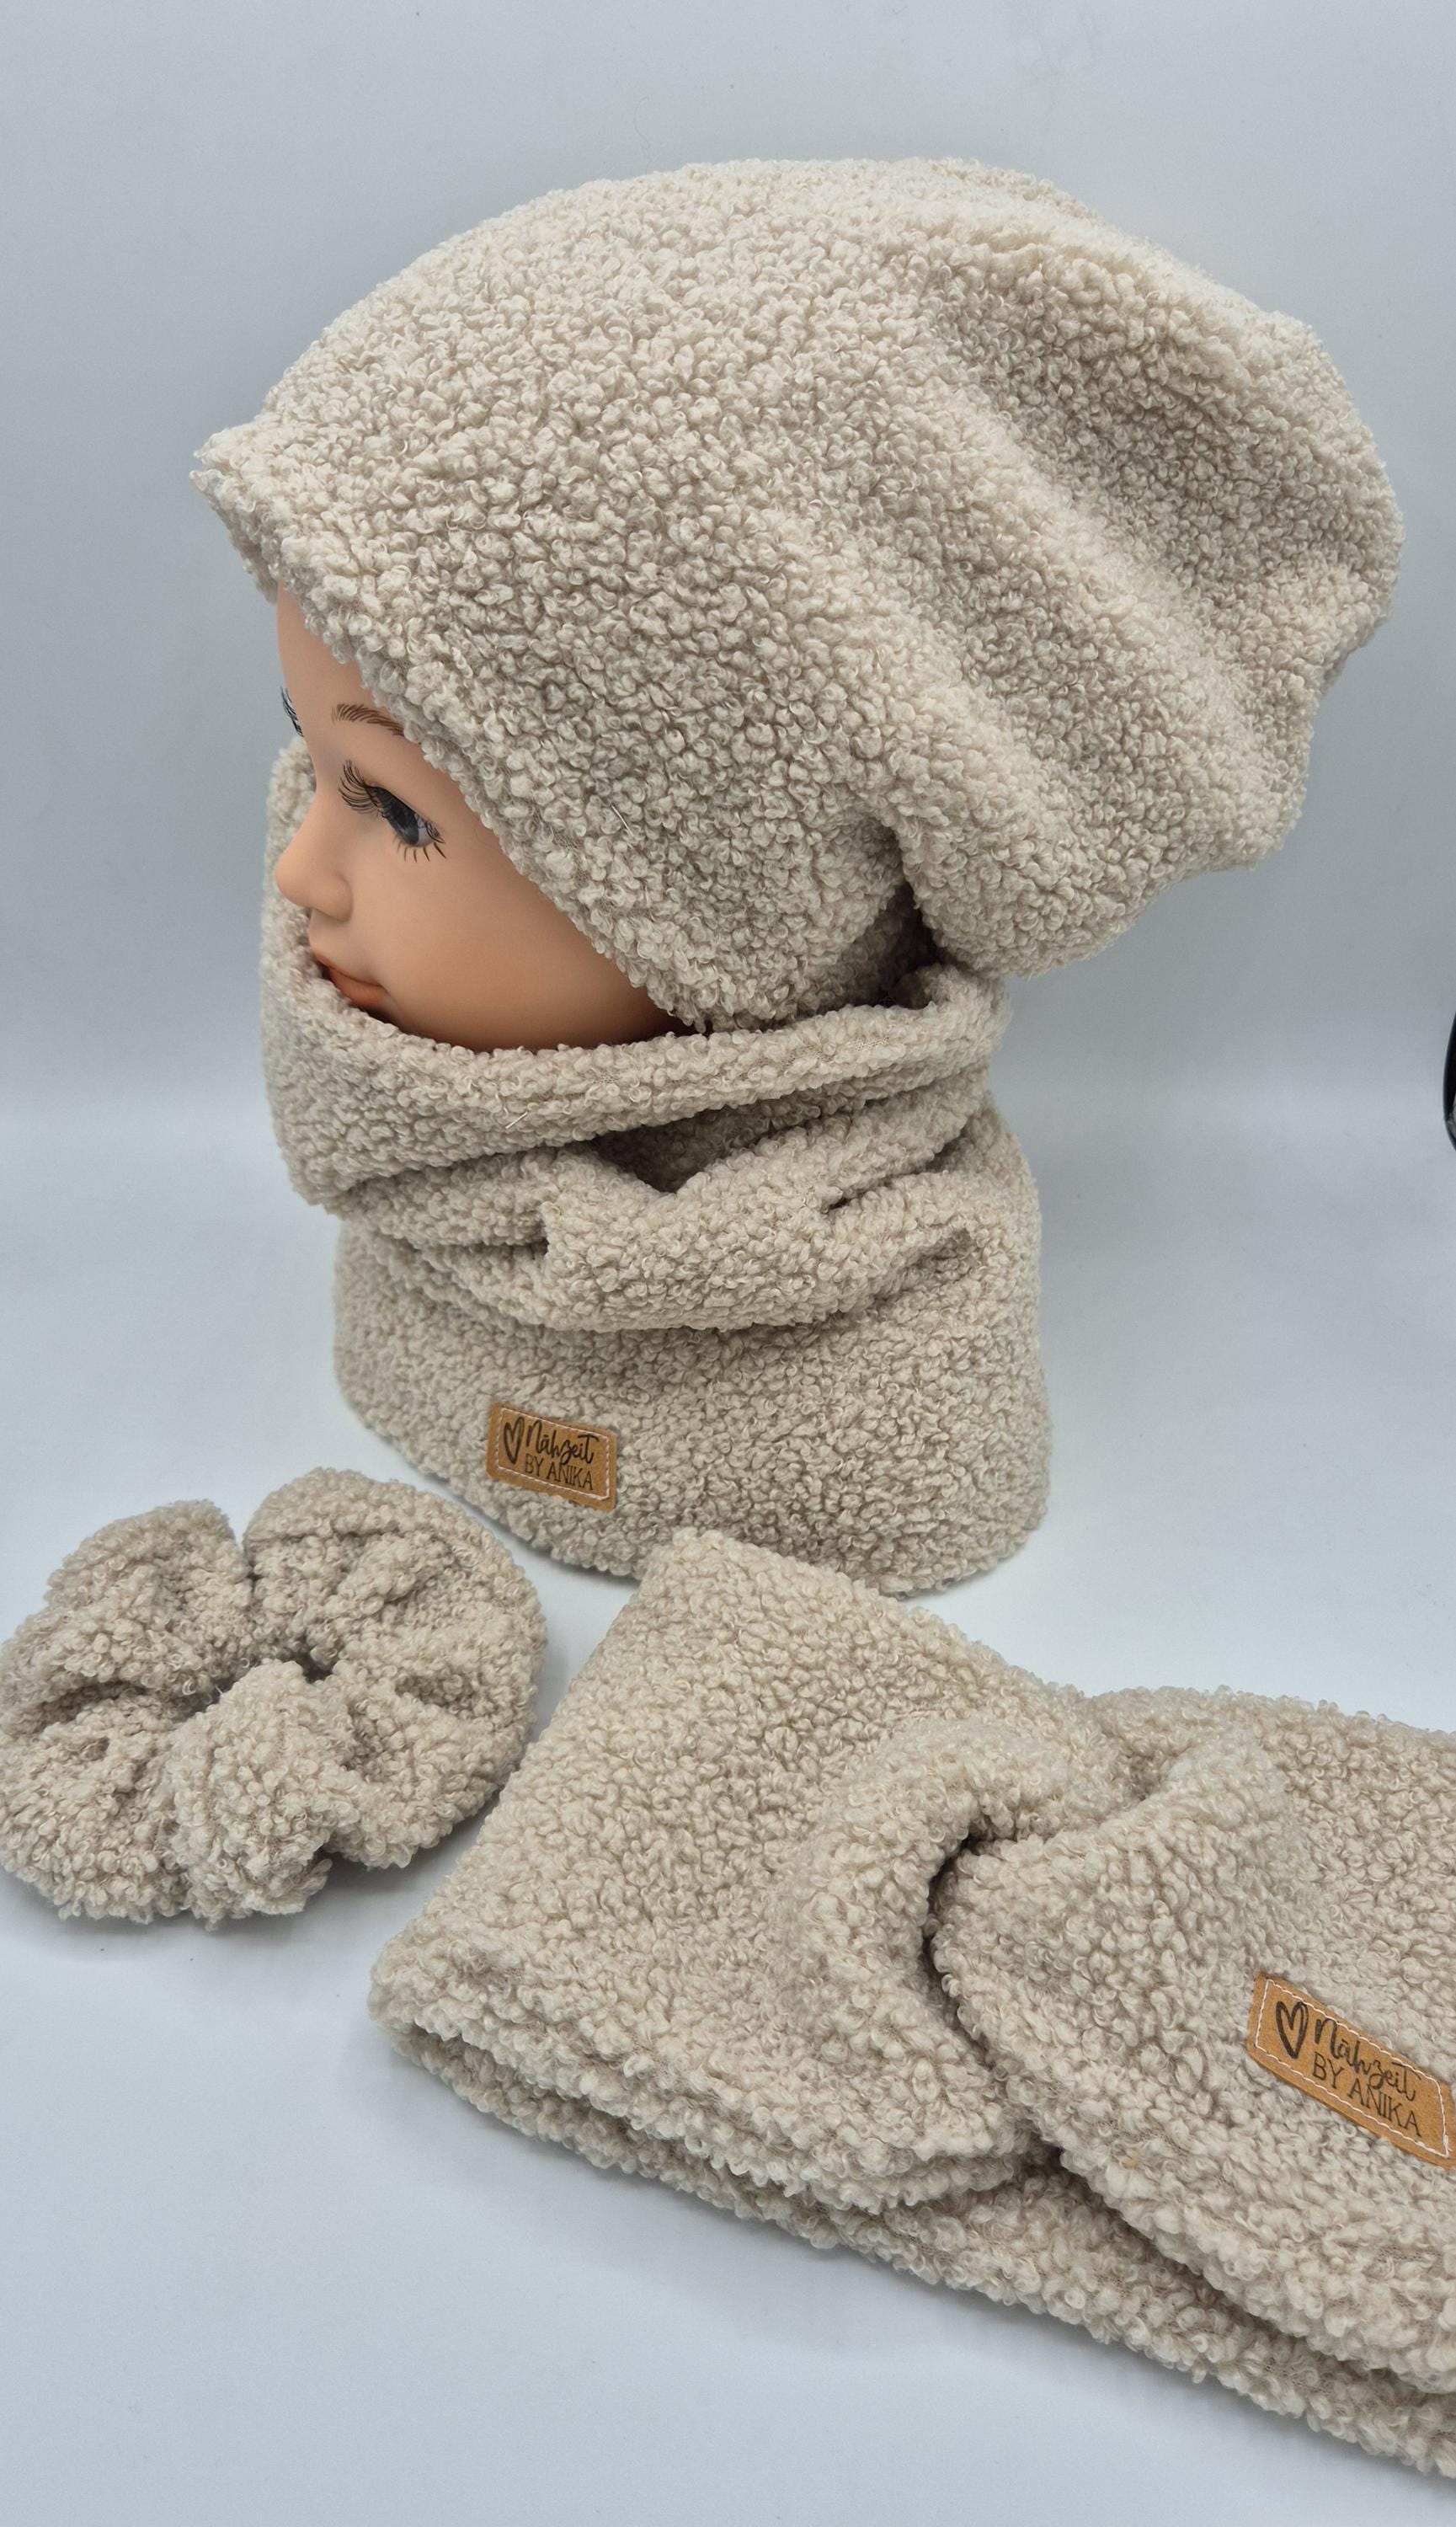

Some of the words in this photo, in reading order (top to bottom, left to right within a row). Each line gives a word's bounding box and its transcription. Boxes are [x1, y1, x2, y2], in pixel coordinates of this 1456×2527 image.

[525, 1453, 545, 1477] BY
[546, 1461, 594, 1491] ANIKA
[1312, 2051, 1345, 2089] BY
[1347, 2078, 1422, 2138] ANIKA
